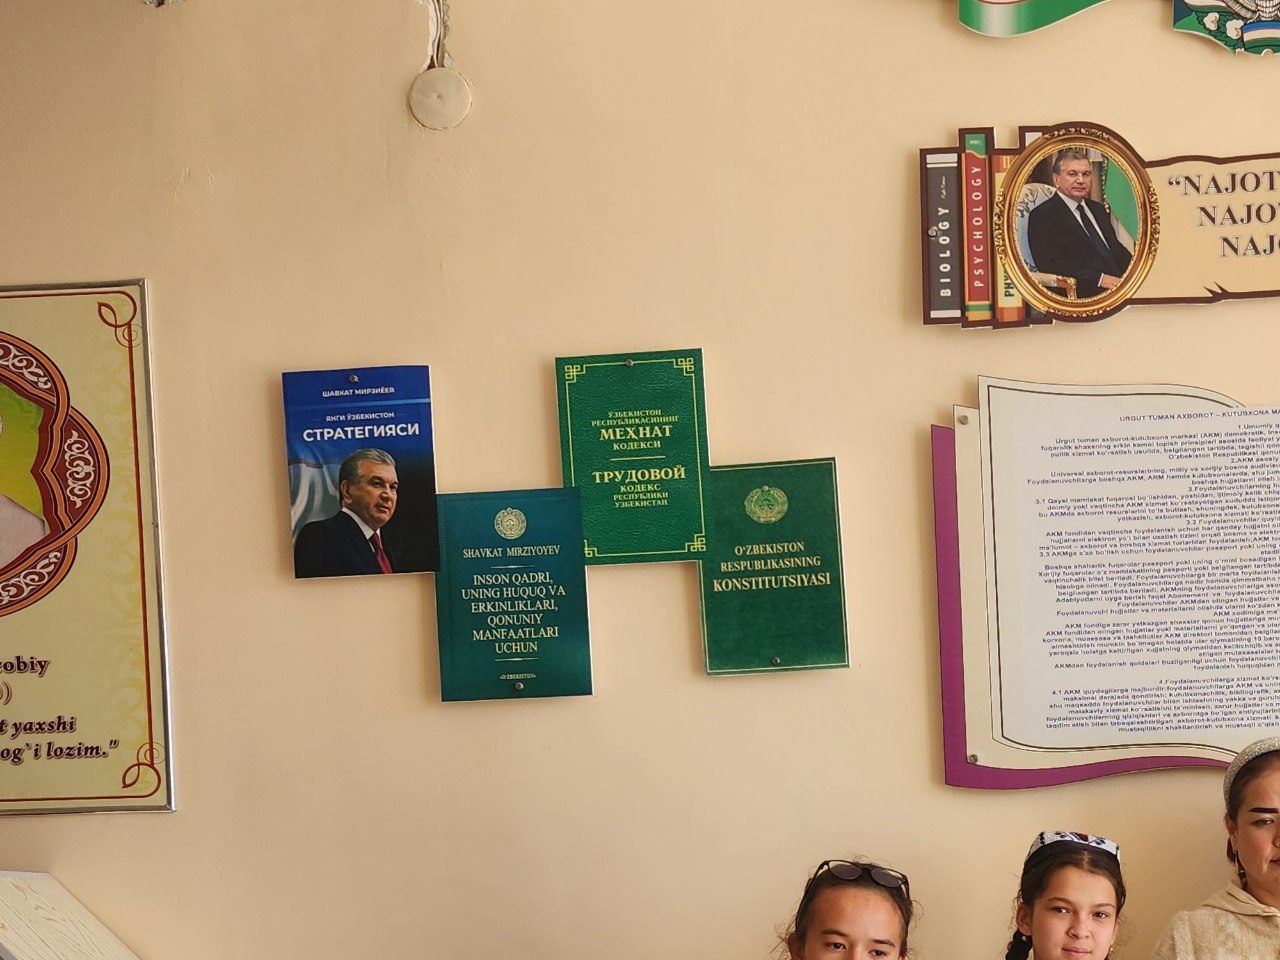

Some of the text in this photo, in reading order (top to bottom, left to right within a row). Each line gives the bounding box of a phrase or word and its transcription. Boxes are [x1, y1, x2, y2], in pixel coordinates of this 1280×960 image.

[1168, 171, 1280, 195] “NAJOT
[972, 166, 984, 287] PSYCHOLOGY
[938, 207, 951, 297] BIOLOGY
[322, 386, 394, 397] ШАВКАТ МИРЗИЁЕВ
[326, 412, 394, 422] ЯНГИ ЎЗБЕКИСТОН
[1222, 409, 1269, 418] KUTUBXONA
[303, 423, 420, 442] СТРАТЕГИЯСИ
[600, 425, 673, 441] МЕҲНАТ
[613, 441, 661, 451] КОДЕКСИ
[592, 465, 685, 483] ТРУДОВОЙ
[620, 484, 661, 492] КОДЕКС
[614, 492, 668, 501] РЕСПУБЛИКИ
[615, 499, 668, 508] УЗБЕКИСТАН
[463, 545, 560, 558] SHAVKAT MIRZIYOYEV
[721, 556, 821, 572] RESPUBLIKASINING
[473, 572, 553, 585] INSON QADRI,
[713, 573, 831, 592] KONSTITUTSIYASI
[462, 585, 566, 599] UNING HUQUQ VA
[471, 600, 558, 613] ERKINLIKLARI,
[488, 614, 543, 626] QONUNIY
[473, 627, 559, 640] MANFAATLARI
[495, 642, 538, 653] UCHUN
[11, 715, 76, 740] yaxshi
